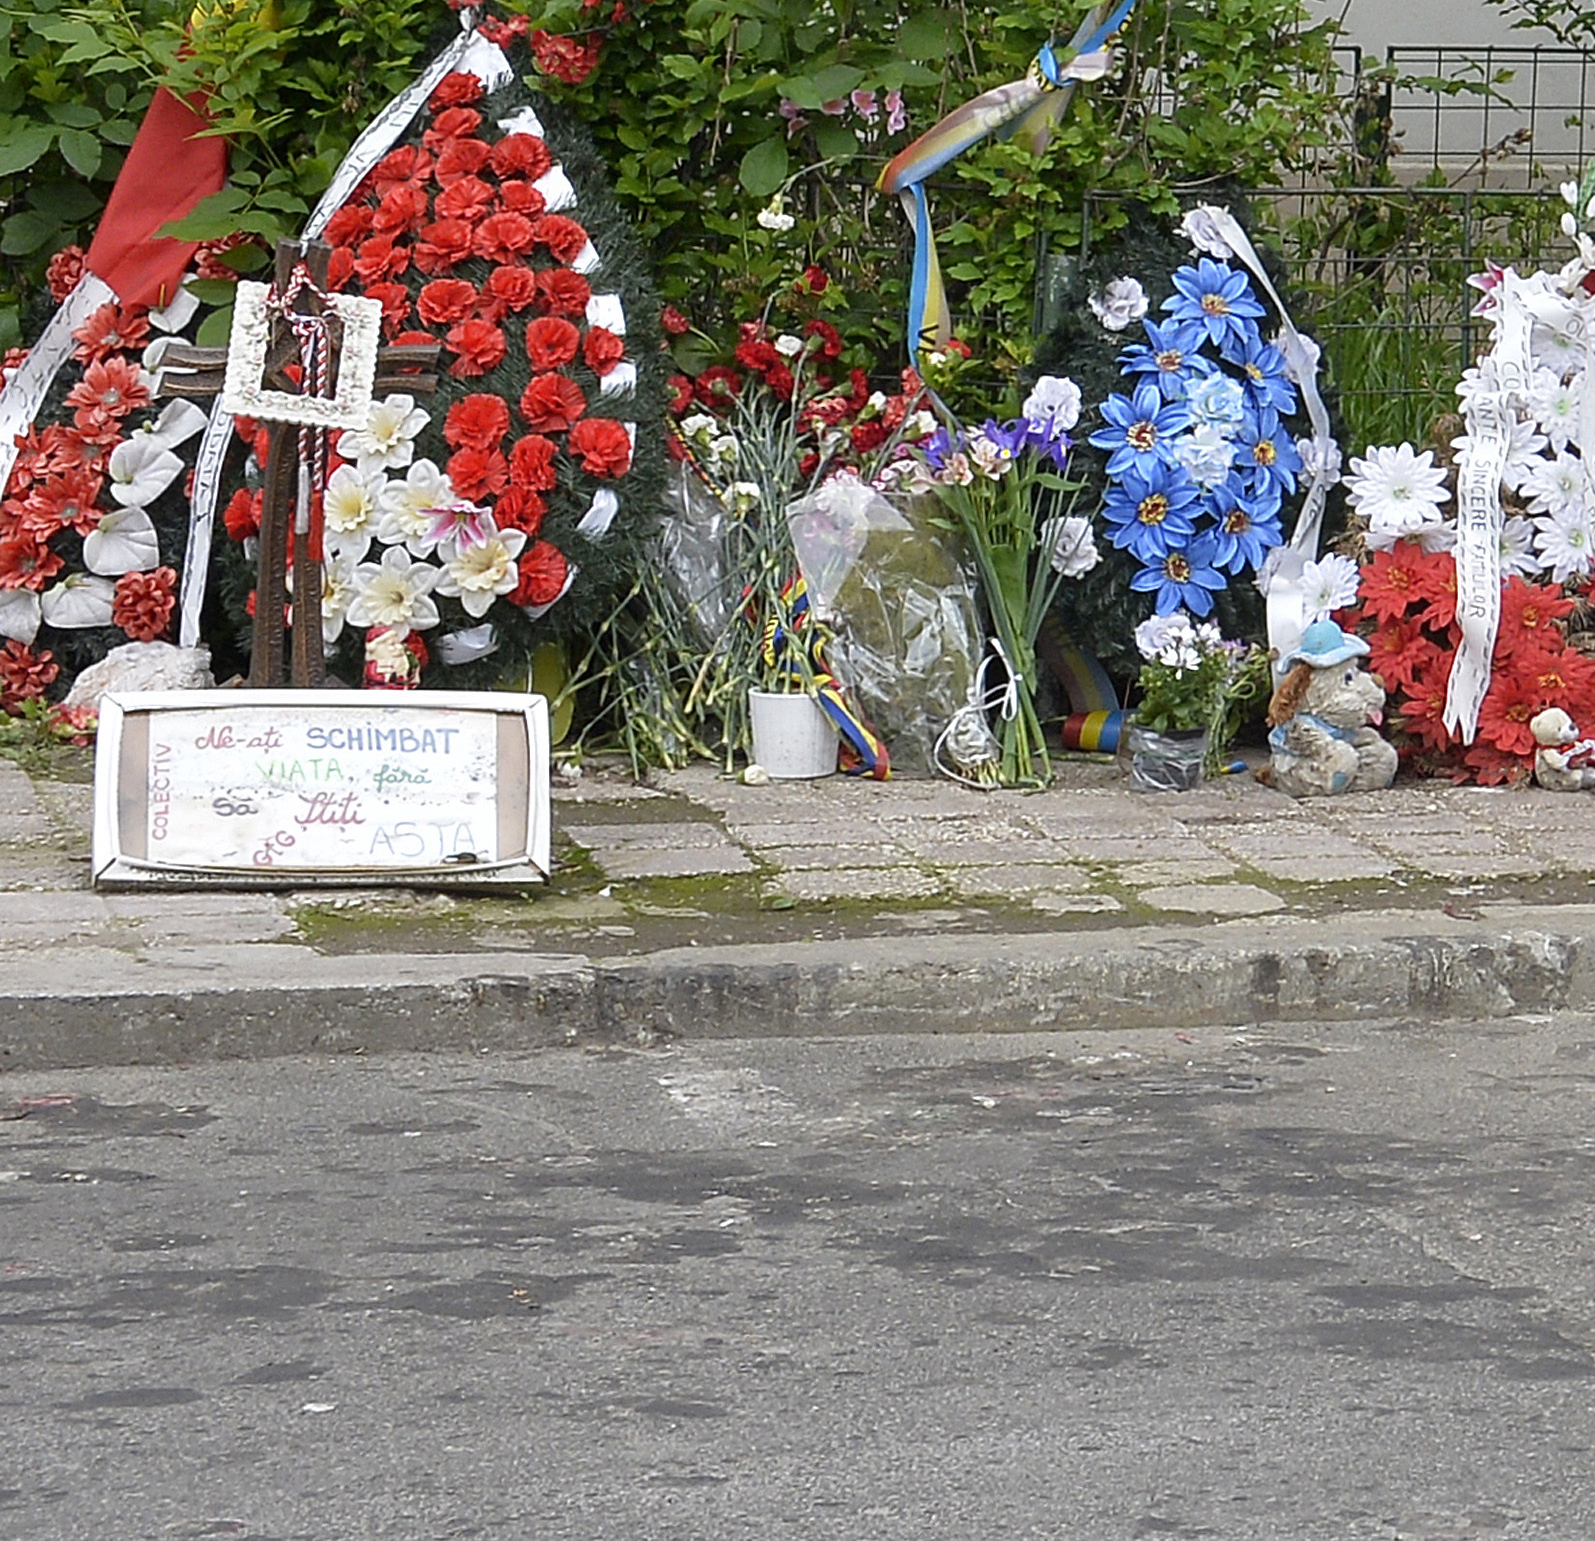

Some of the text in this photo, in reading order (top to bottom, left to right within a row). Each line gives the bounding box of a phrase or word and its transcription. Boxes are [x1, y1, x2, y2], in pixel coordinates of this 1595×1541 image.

[1470, 459, 1491, 531] SINCERE
[307, 721, 460, 755] SCHIMBAT
[151, 743, 173, 841] COLECTIV
[369, 821, 477, 858] ASTA
